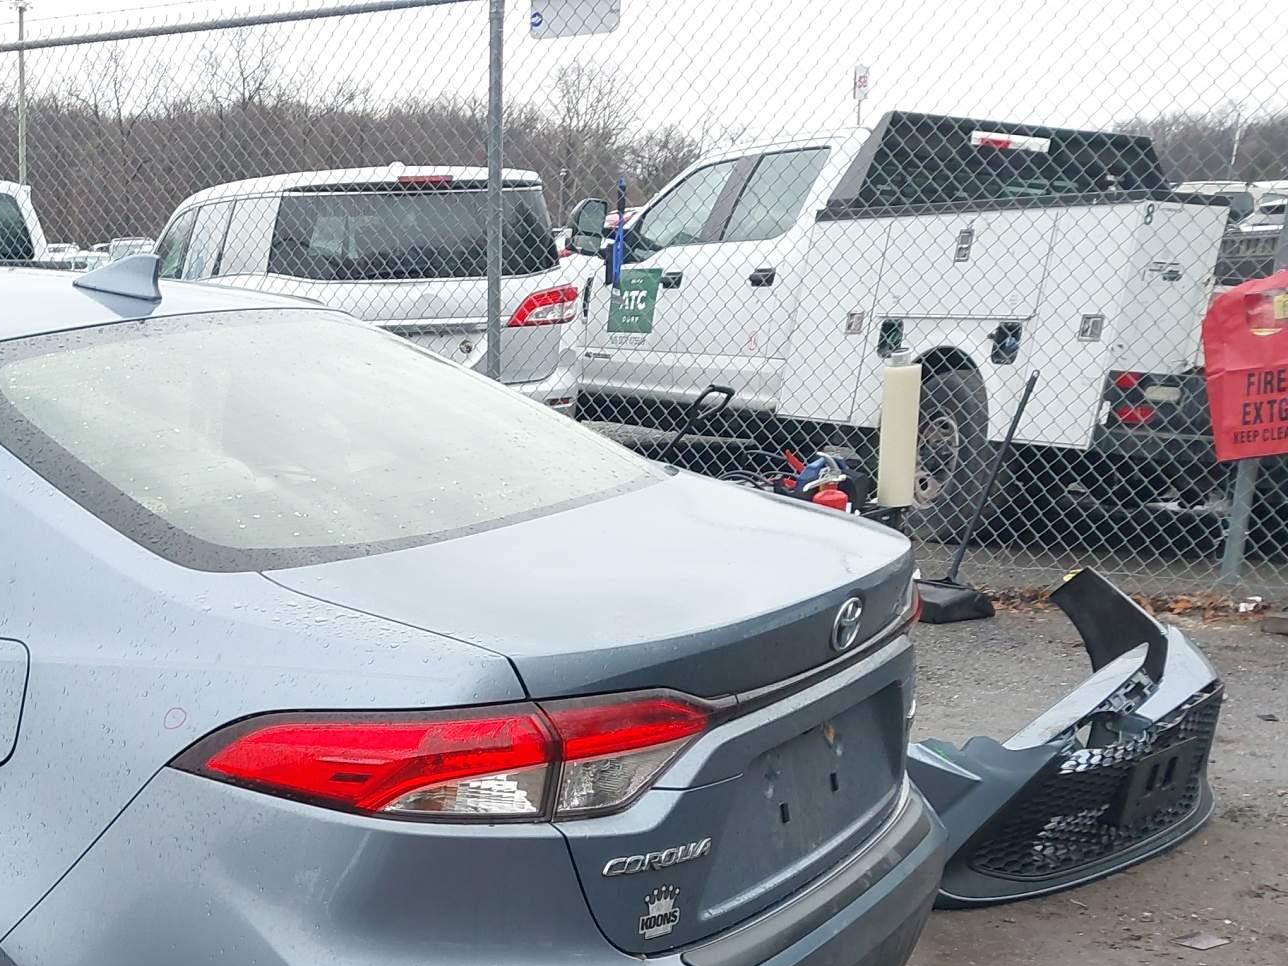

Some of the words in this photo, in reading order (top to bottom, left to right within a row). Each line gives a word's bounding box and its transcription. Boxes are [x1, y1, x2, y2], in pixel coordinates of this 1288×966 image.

[1144, 203, 1155, 226] 8
[619, 290, 648, 310] ATC
[1246, 368, 1287, 396] FIRE
[1233, 430, 1260, 444] KEEP
[602, 837, 712, 877] COROLLA
[640, 909, 679, 931] KOONS
